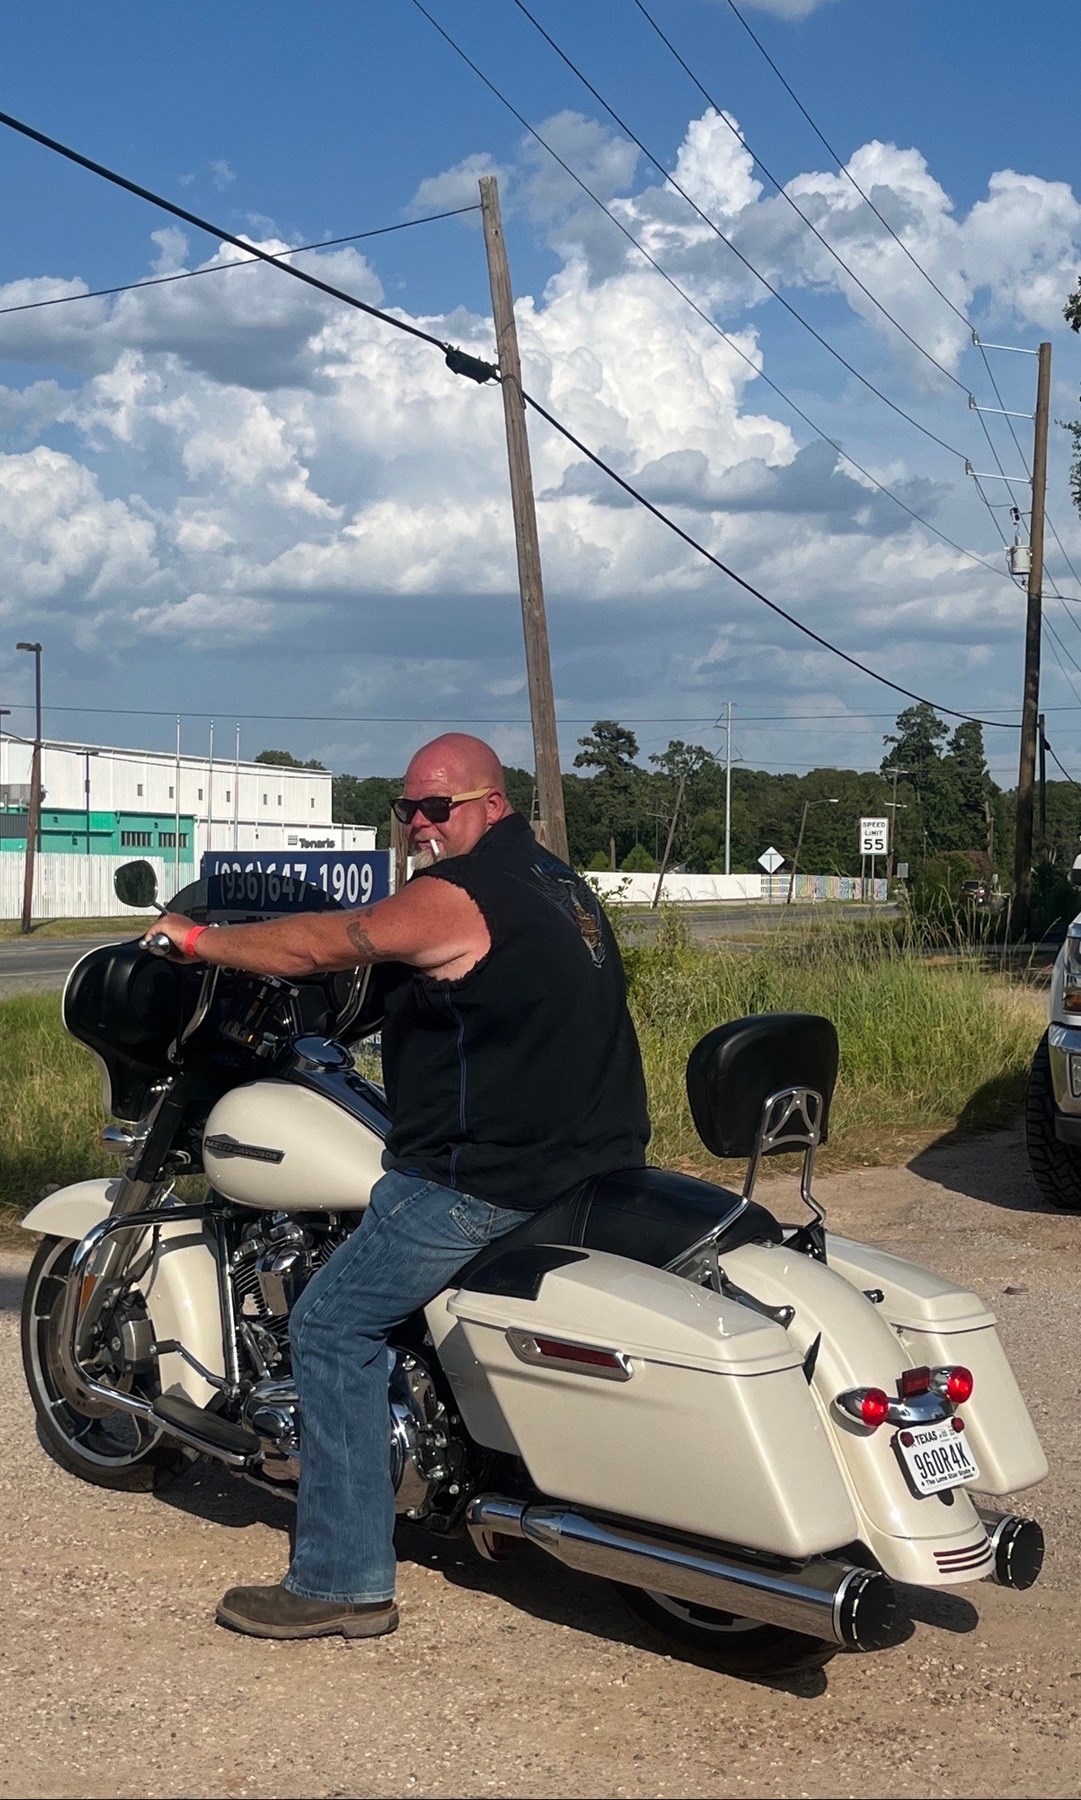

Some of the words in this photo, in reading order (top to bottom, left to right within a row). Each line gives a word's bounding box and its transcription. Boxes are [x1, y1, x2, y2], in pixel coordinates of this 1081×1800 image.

[299, 837, 336, 849] Tenaris
[864, 838, 884, 850] 55
[215, 861, 374, 907] (936)647-1909
[914, 1430, 938, 1445] TEXAS
[914, 1441, 971, 1479] 960R4K
[936, 1475, 948, 1483] Lone
[948, 1471, 958, 1479] Star
[958, 1468, 971, 1476] State
